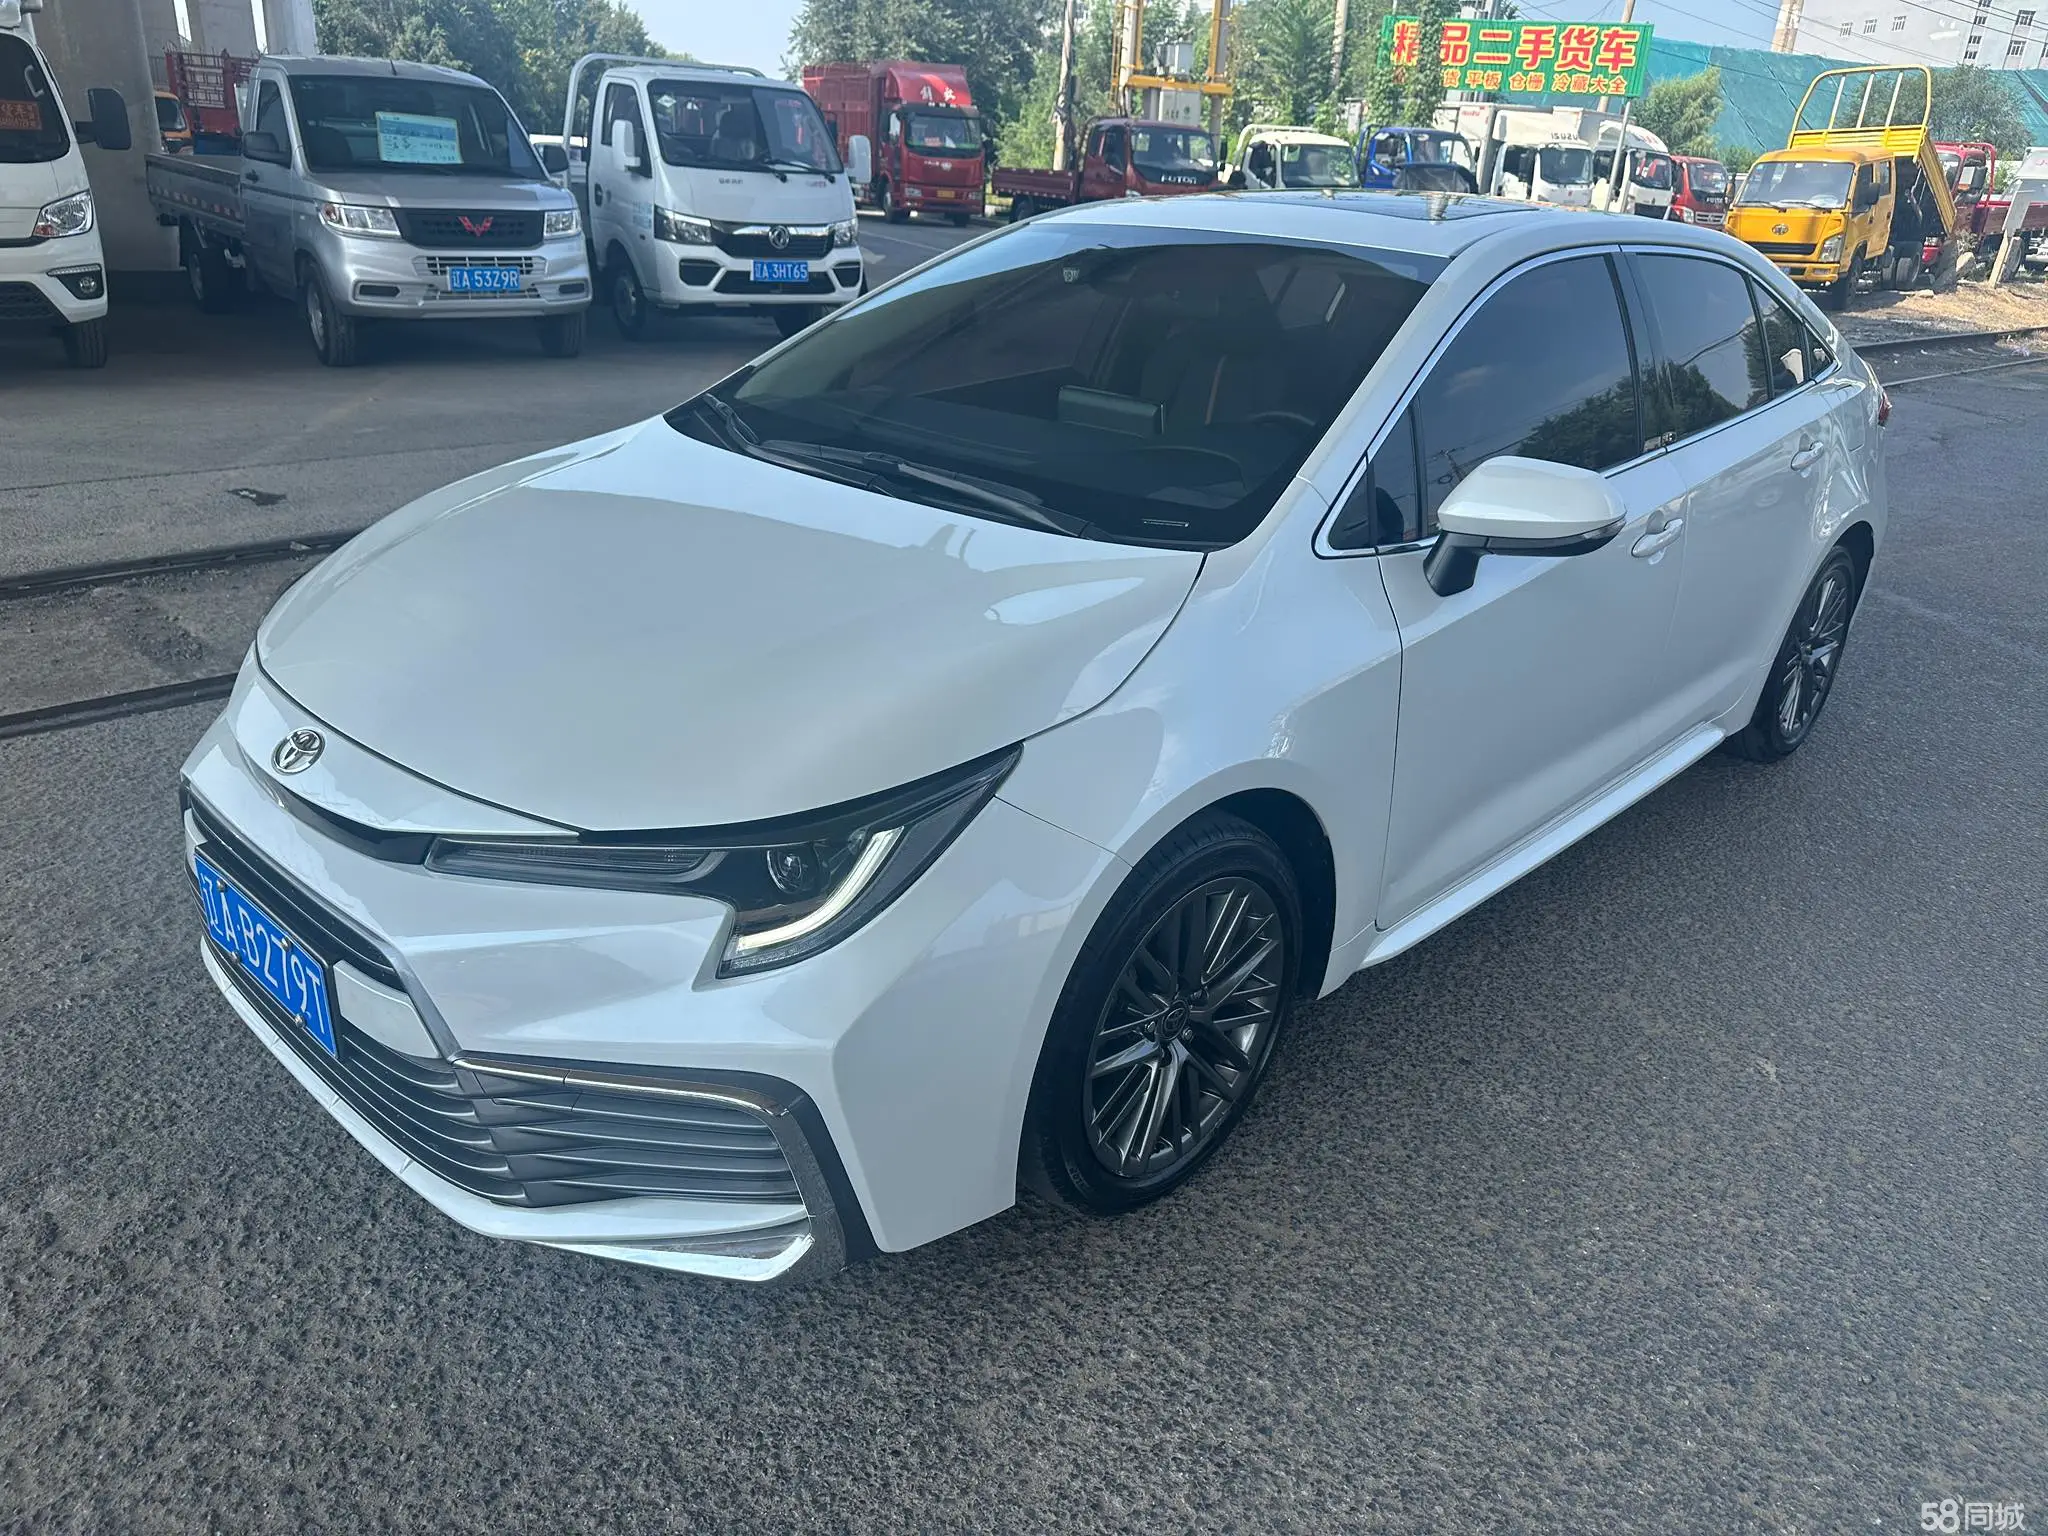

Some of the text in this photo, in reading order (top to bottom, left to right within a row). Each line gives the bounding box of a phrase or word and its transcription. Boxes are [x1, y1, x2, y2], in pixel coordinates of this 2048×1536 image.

[1390, 20, 1639, 73] 精品二手货车
[1465, 70, 1502, 89] 平板
[1552, 73, 1627, 94] 冷藏大全
